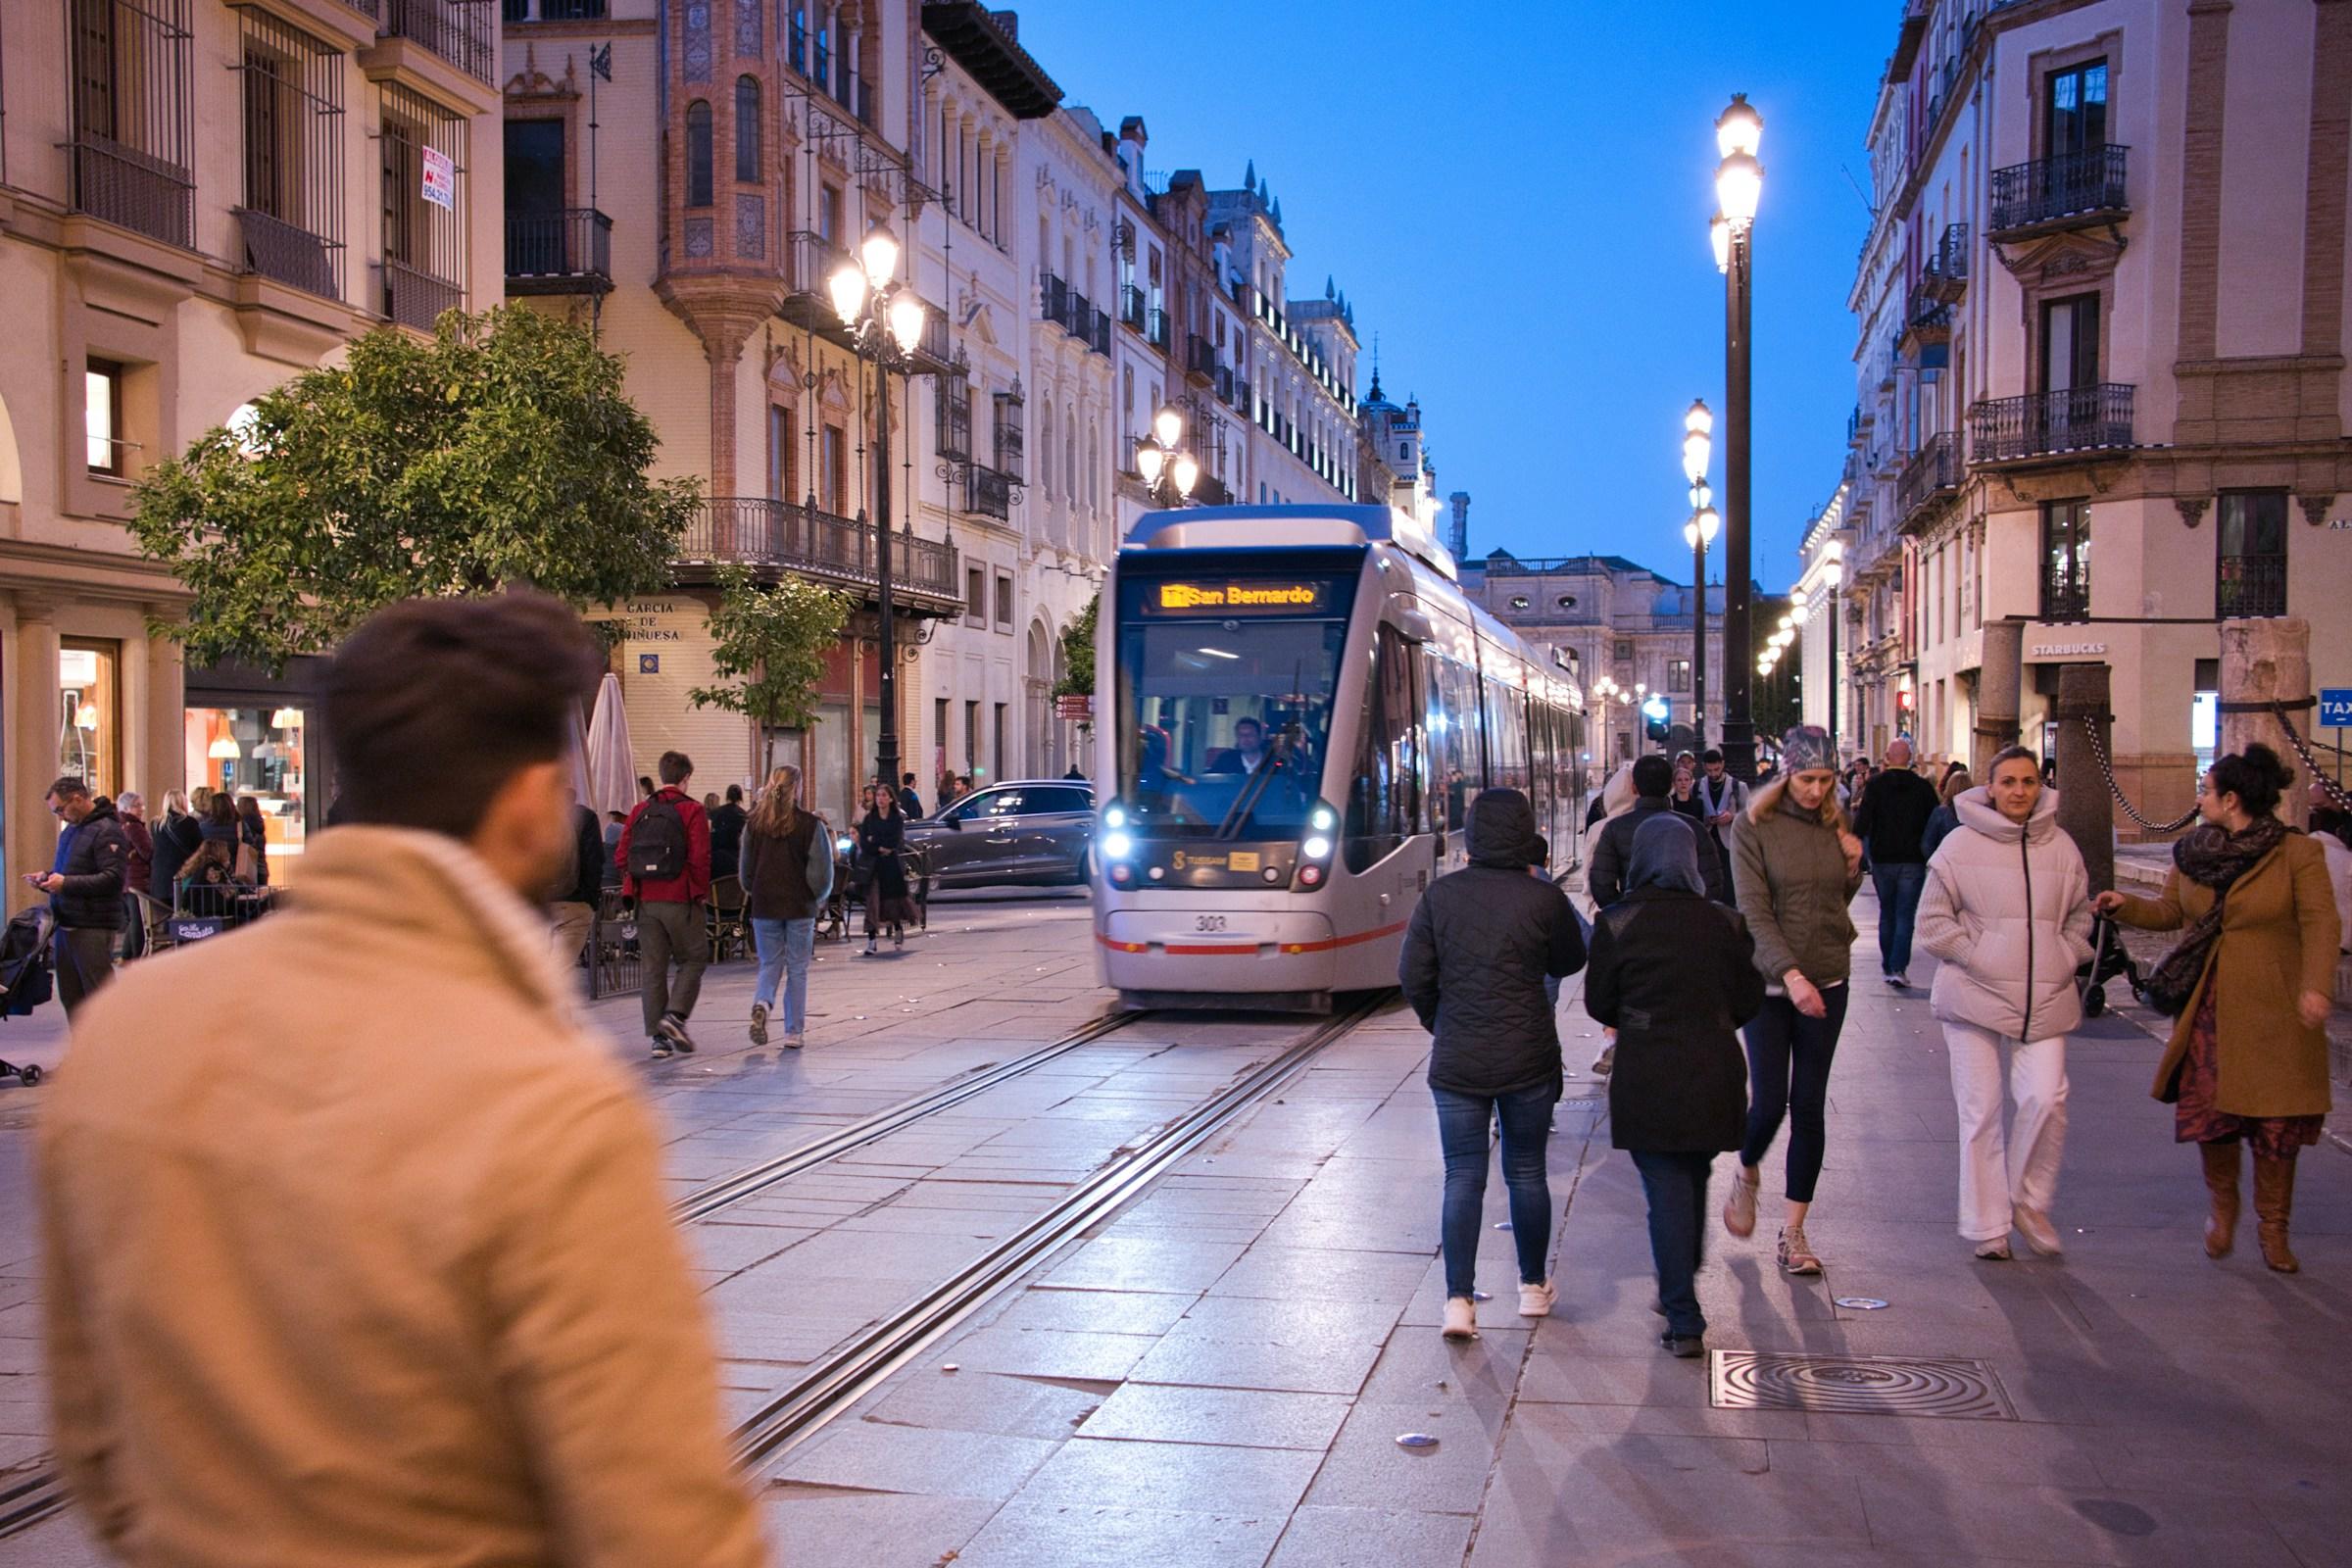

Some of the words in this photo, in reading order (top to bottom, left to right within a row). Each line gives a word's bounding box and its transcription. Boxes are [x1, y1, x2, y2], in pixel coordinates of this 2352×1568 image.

[1189, 588, 1224, 605] San
[1227, 586, 1314, 604] Bernardo
[640, 616, 658, 626] DE
[2031, 643, 2106, 657] STARBUCKS
[1196, 915, 1225, 932] 303
